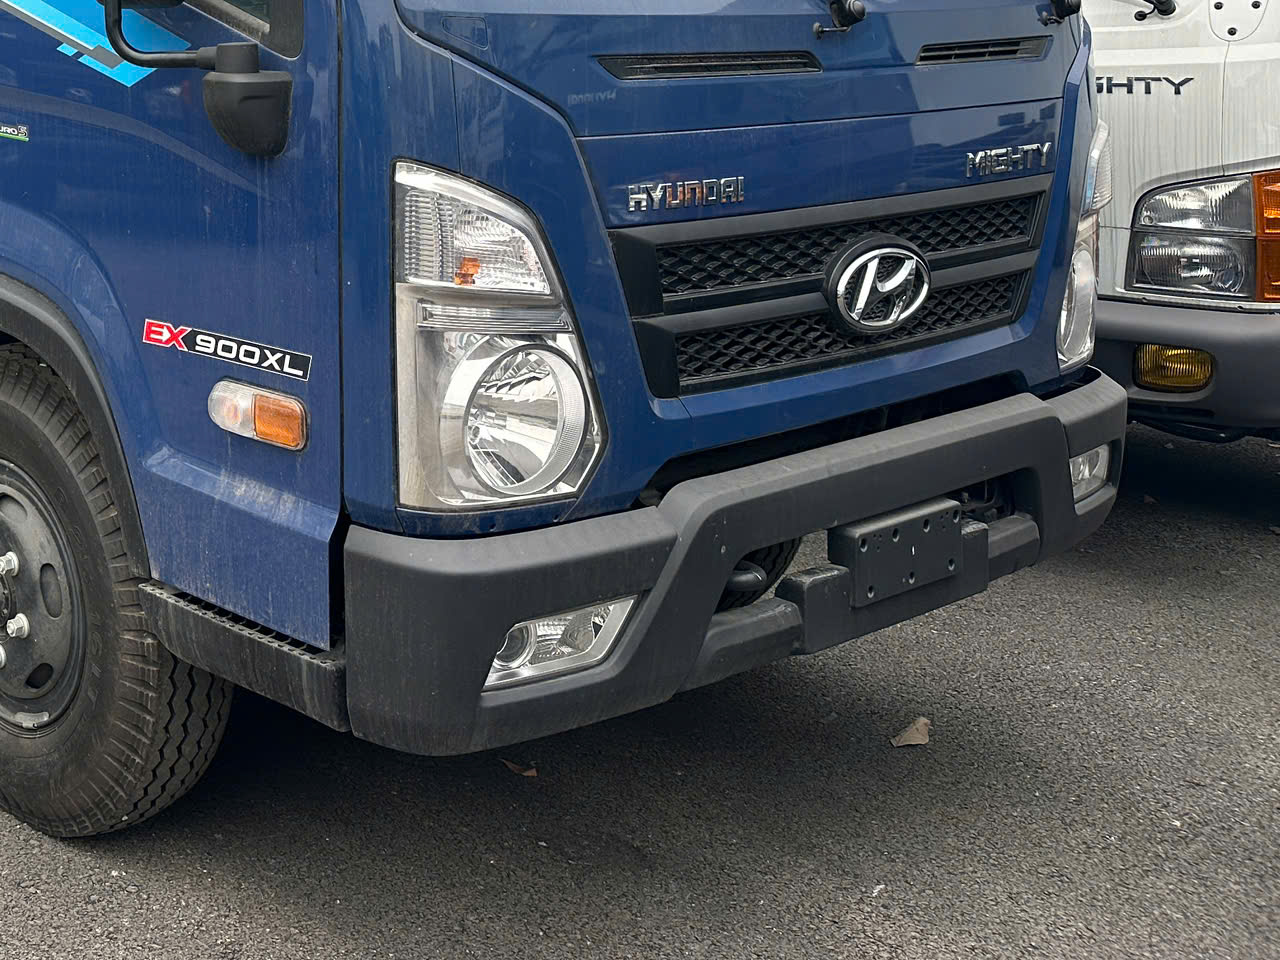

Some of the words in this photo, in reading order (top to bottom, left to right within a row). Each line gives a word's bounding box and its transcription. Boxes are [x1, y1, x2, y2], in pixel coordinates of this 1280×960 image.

[966, 142, 1052, 178] MIGHTY
[628, 176, 745, 212] HYUNDAI
[143, 319, 192, 352] EX
[195, 334, 304, 377] 900XL
